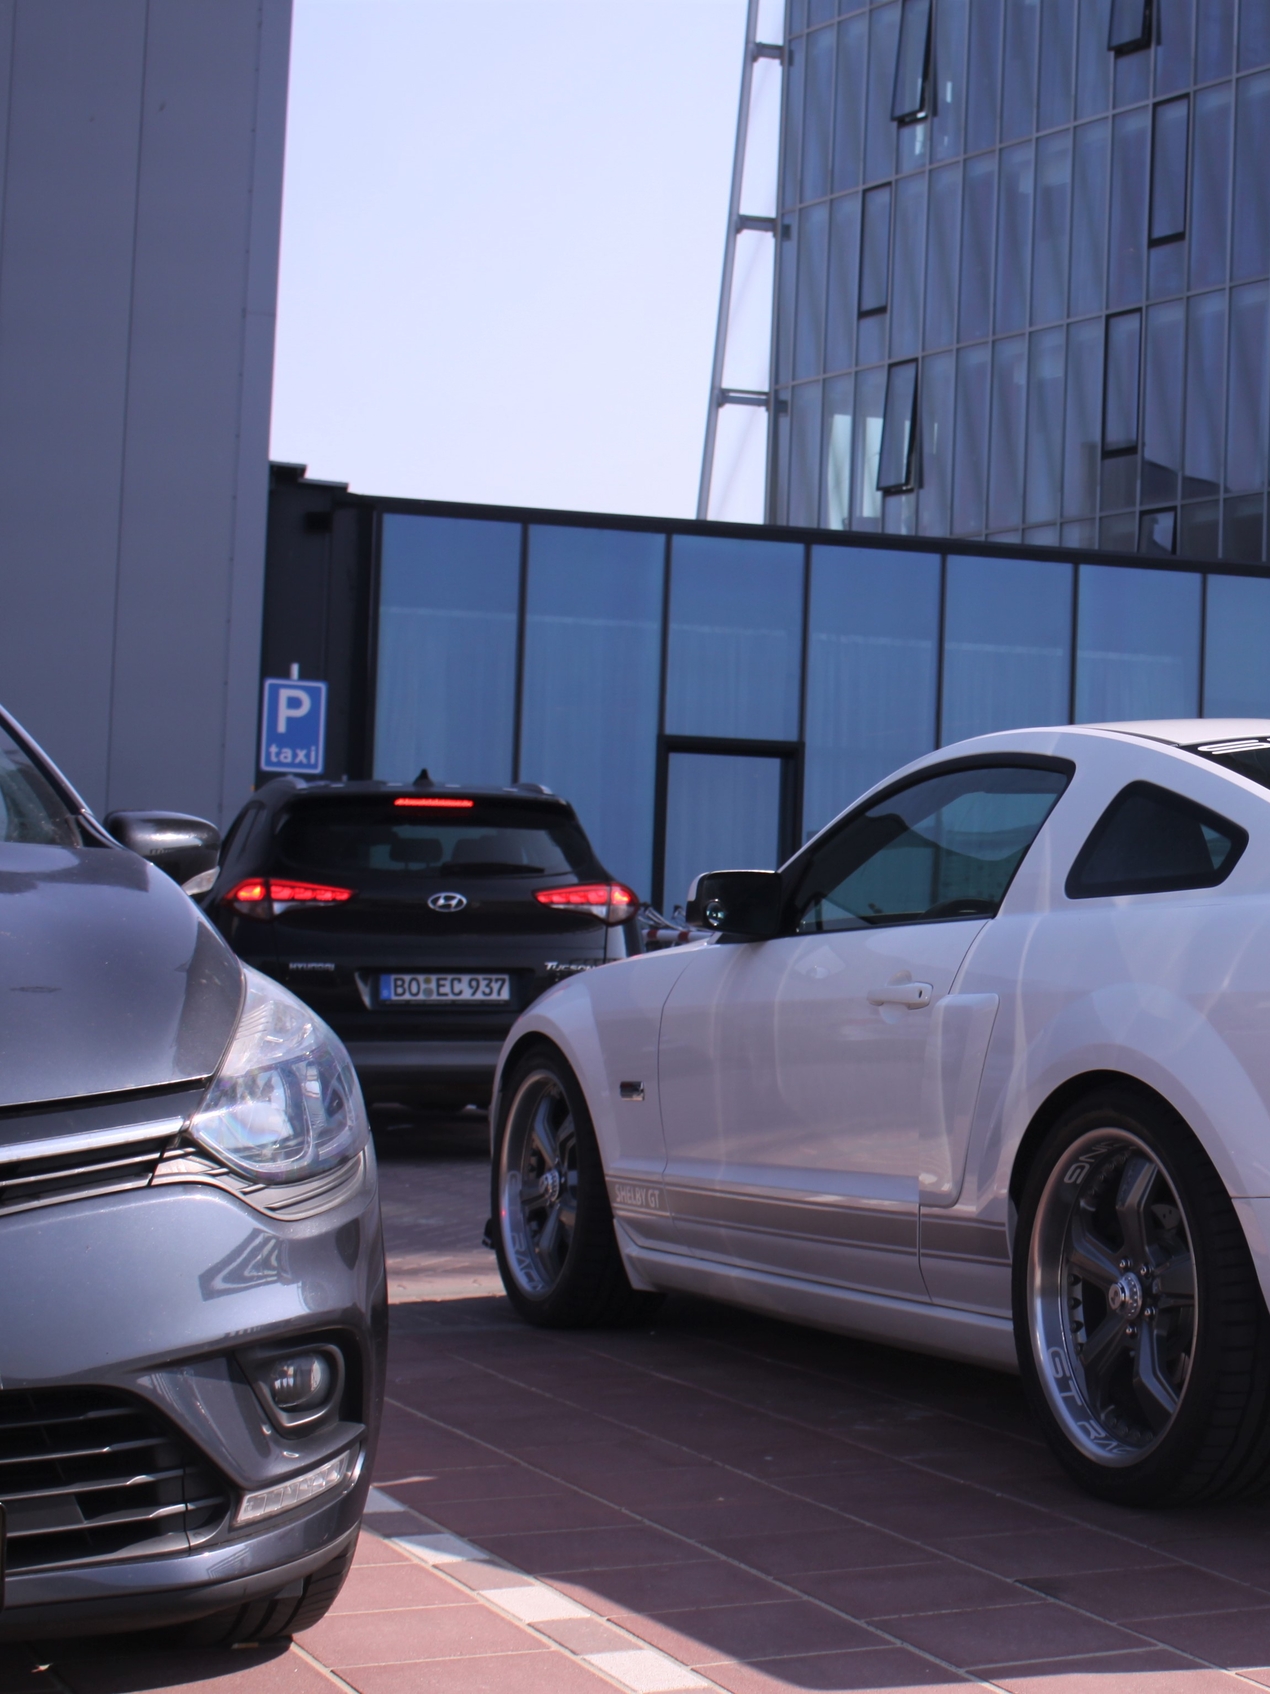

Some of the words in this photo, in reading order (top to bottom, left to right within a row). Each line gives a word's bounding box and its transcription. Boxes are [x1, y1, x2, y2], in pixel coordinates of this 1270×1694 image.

[277, 688, 311, 733] P
[269, 744, 316, 764] taxi
[393, 977, 421, 998] BO
[436, 977, 463, 999] EC
[469, 977, 507, 999] 937
[614, 1184, 646, 1207] SHELBY
[648, 1189, 660, 1208] GT
